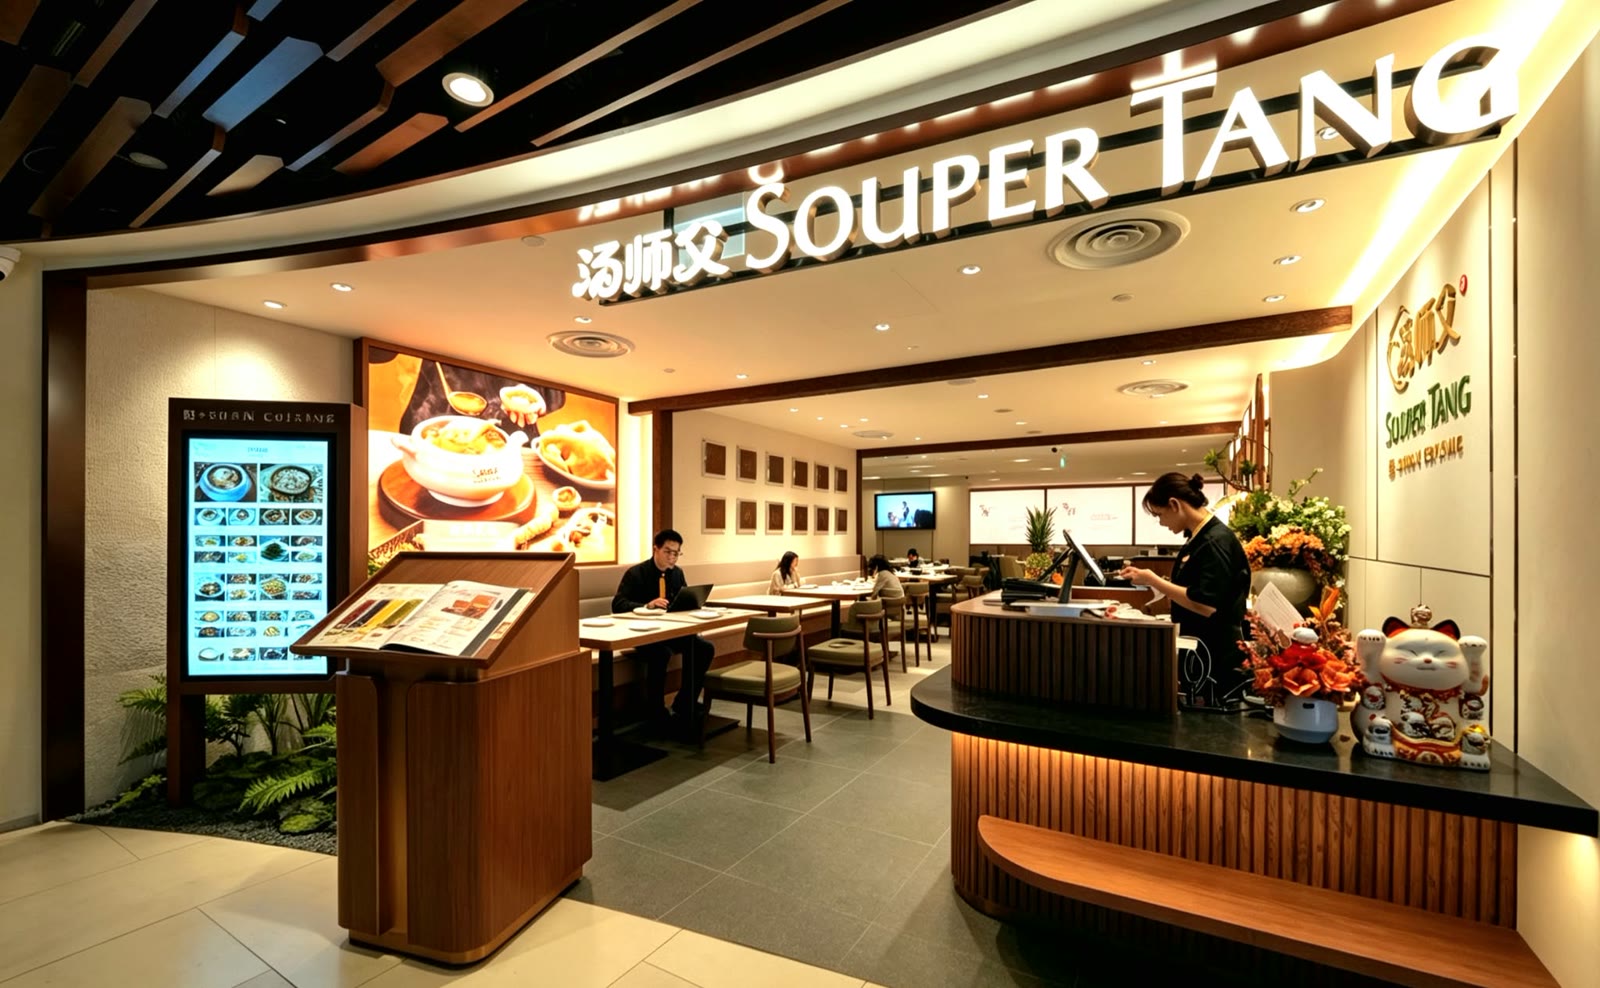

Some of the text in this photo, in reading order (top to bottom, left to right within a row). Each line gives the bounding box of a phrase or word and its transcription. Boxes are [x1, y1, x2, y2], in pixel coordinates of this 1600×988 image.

[745, 33, 1520, 271] SOUPER TANG
[571, 219, 730, 299] 汤师父
[1427, 375, 1472, 430] TANG
